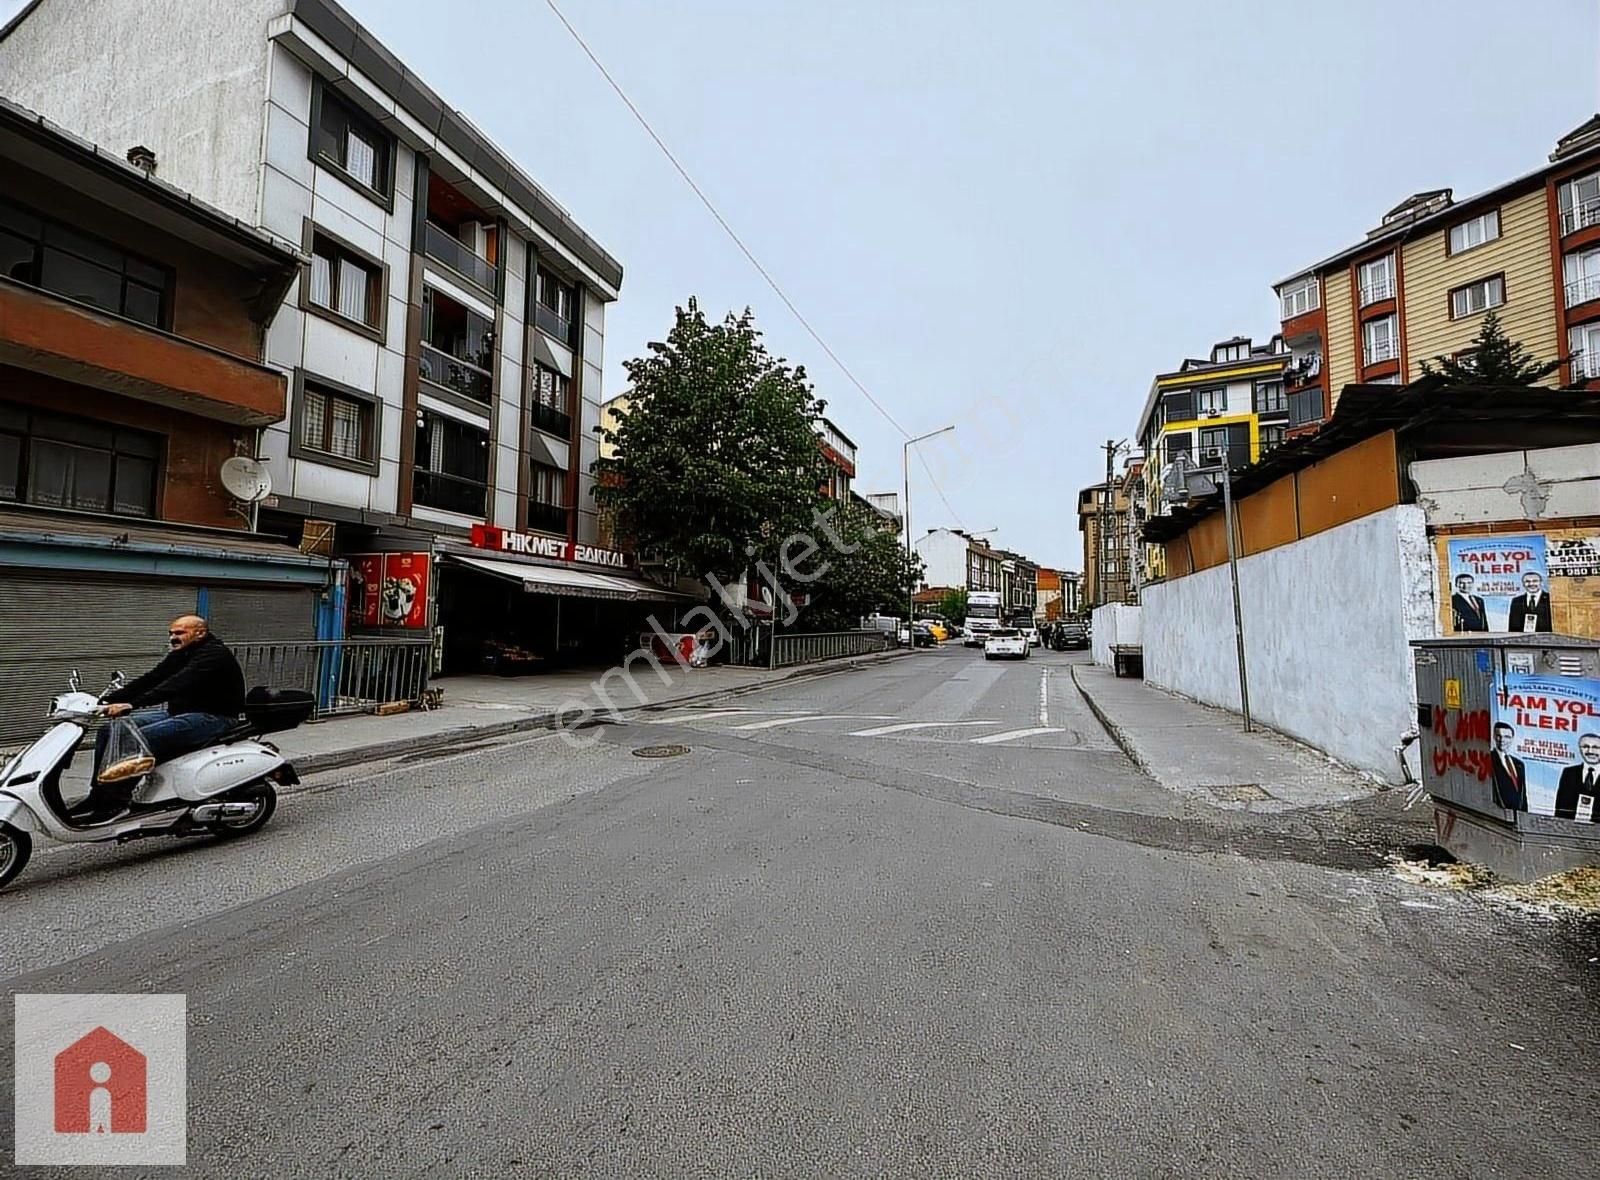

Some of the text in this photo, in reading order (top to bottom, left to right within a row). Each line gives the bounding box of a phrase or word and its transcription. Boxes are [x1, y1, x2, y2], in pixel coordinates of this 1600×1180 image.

[1458, 551, 1537, 562] TAM YOL
[1475, 561, 1520, 574] İLERİ
[1552, 698, 1600, 717] YOL
[1516, 708, 1578, 732] İLERİ
